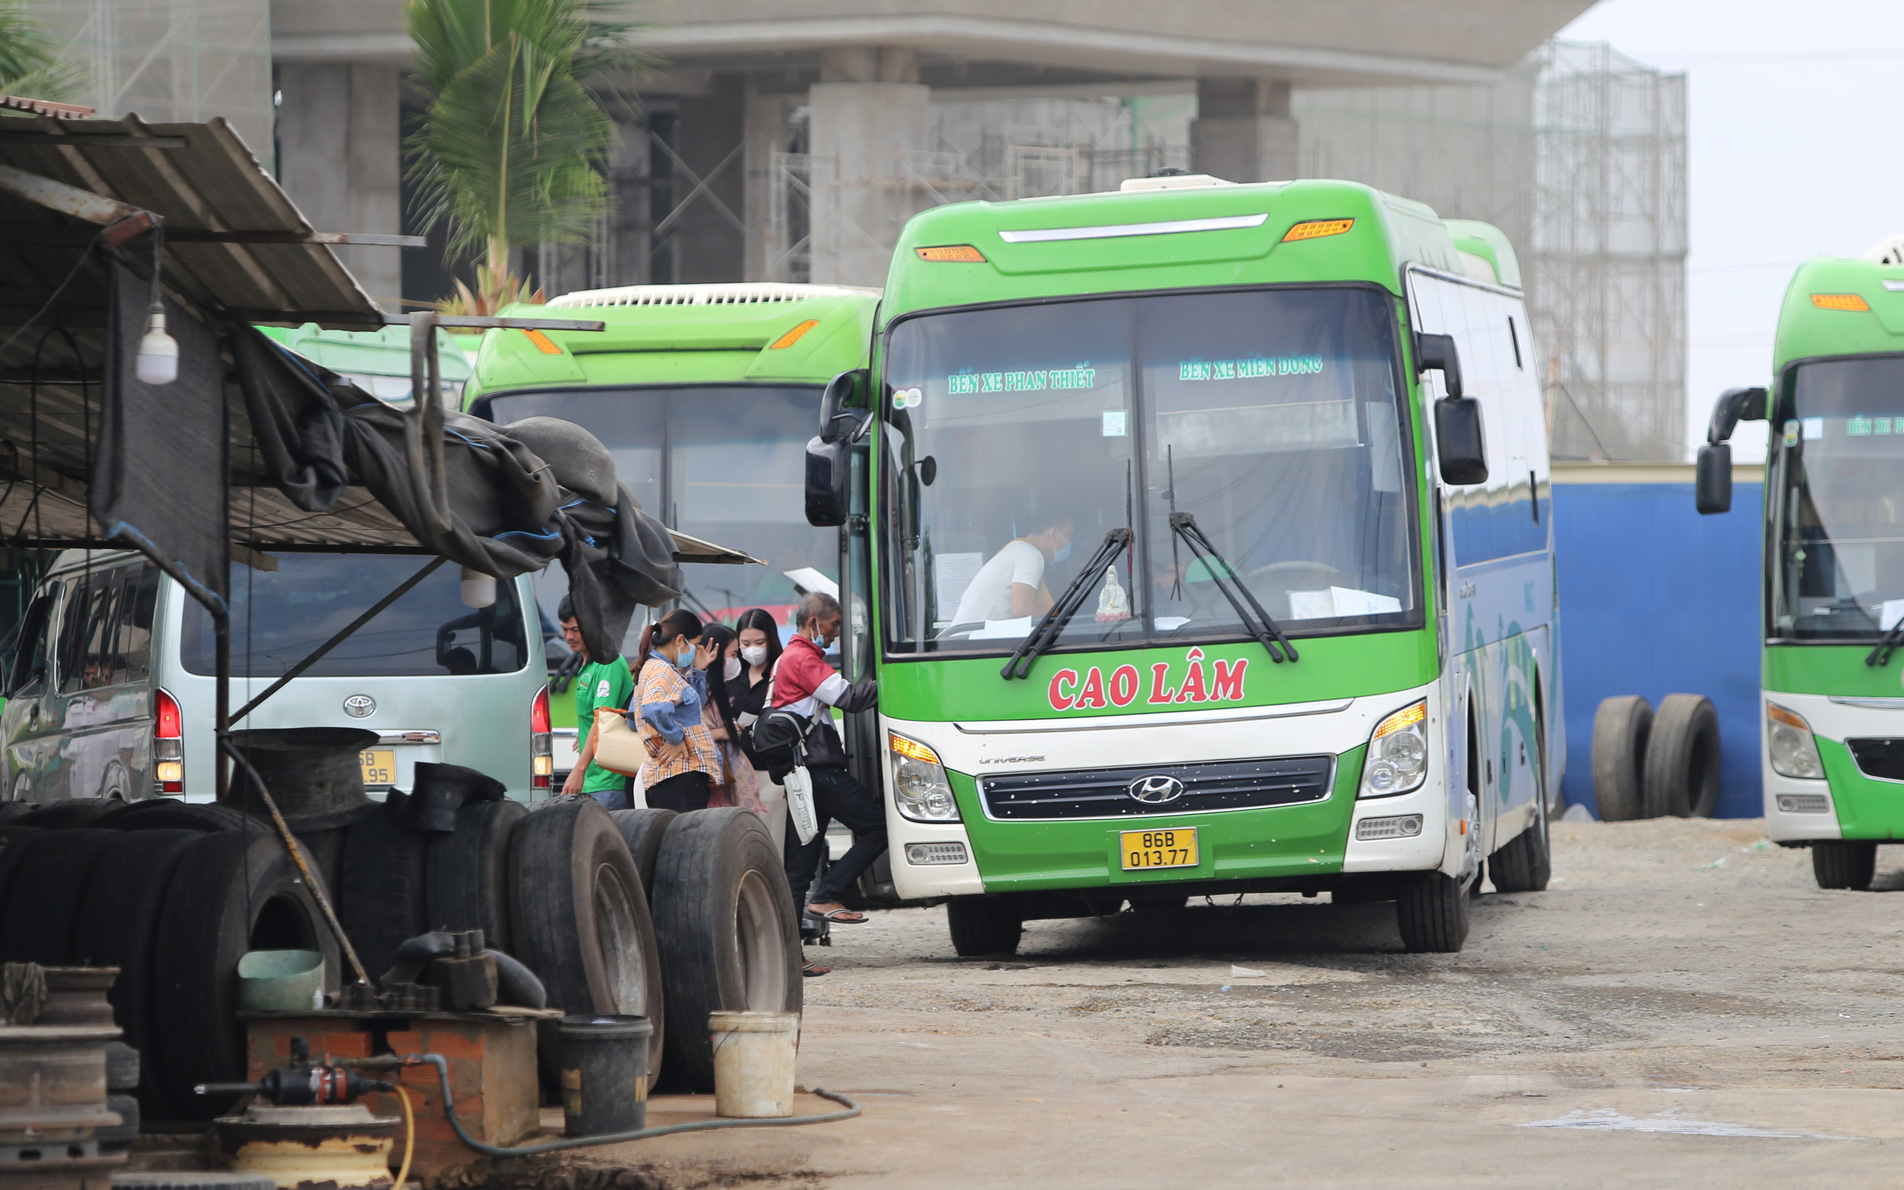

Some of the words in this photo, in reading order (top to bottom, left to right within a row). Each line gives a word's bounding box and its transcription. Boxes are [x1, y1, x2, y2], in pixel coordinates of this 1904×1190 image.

[948, 367, 979, 394] BẾN
[981, 372, 1003, 392] XE
[1004, 370, 1048, 391] PHAN
[1050, 360, 1095, 389] THIẾT
[1179, 354, 1211, 380] BẾN
[1213, 359, 1235, 380] XE
[1278, 350, 1323, 376] ĐÔNG
[1048, 664, 1139, 711] CAO
[1147, 646, 1249, 704] LÂM
[979, 754, 1046, 765] UNIVERSE
[1143, 831, 1175, 848] 86B
[1130, 848, 1189, 867] 013.77
